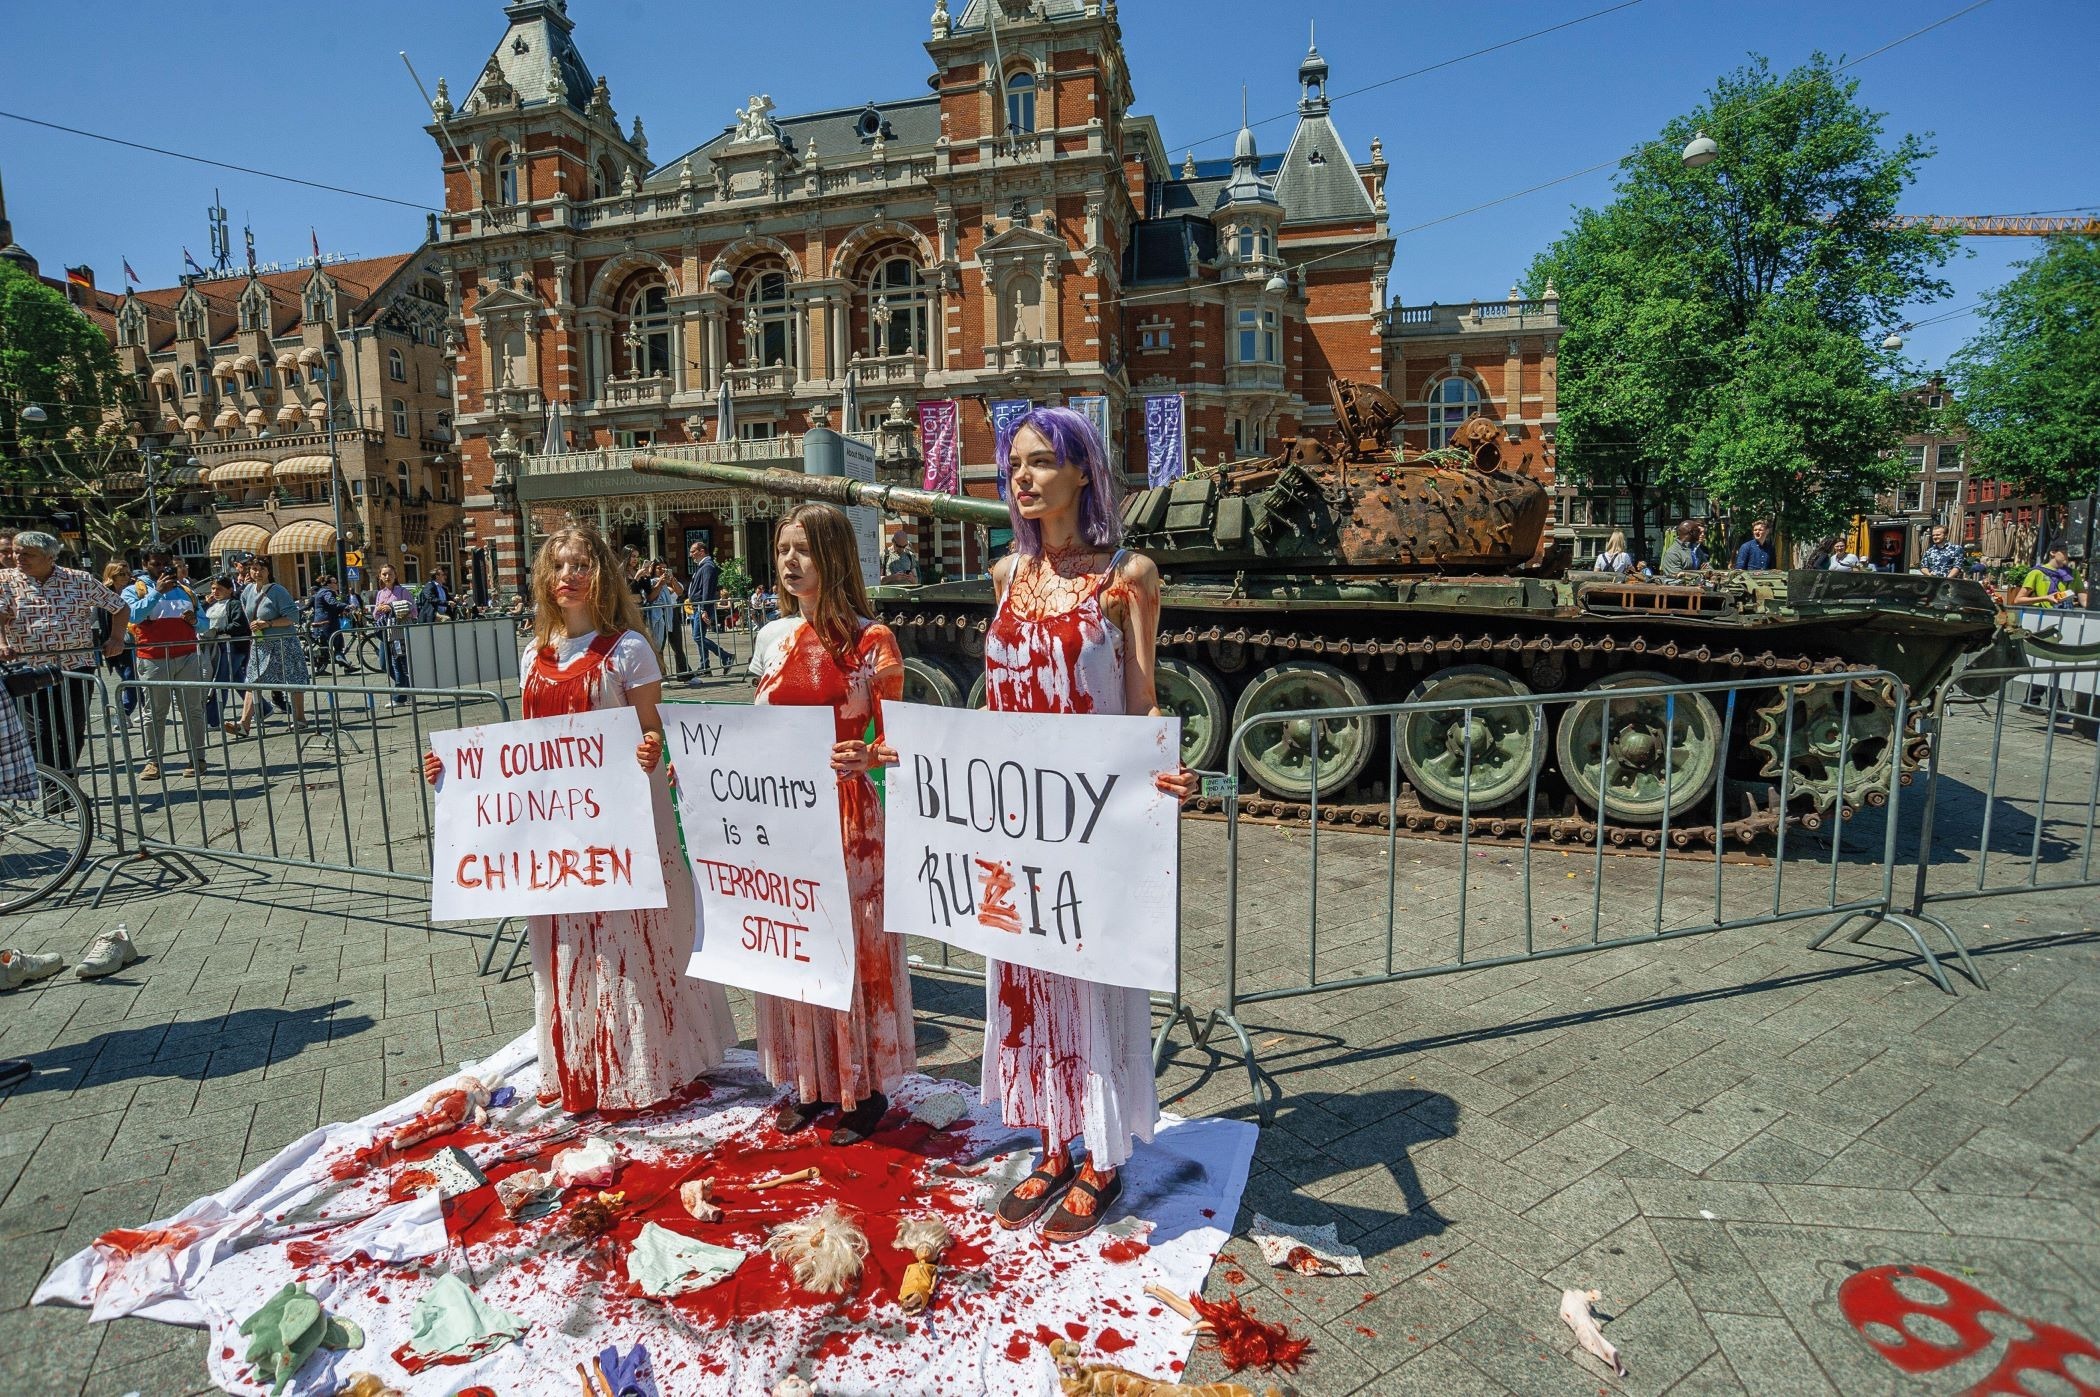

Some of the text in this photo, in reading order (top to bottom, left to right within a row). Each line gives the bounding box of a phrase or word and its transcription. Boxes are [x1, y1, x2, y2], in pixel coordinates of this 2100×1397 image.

[207, 251, 346, 280] AMERICAN HOTEL
[457, 734, 604, 779] MY COUNTRY
[680, 721, 722, 756] MY
[477, 788, 601, 827] KIDNAPS
[914, 753, 1120, 844] BLOODY
[722, 818, 770, 845] is a
[457, 845, 632, 891] CHILDREN
[697, 858, 820, 912] TERRORIST
[742, 915, 810, 962] STATE
